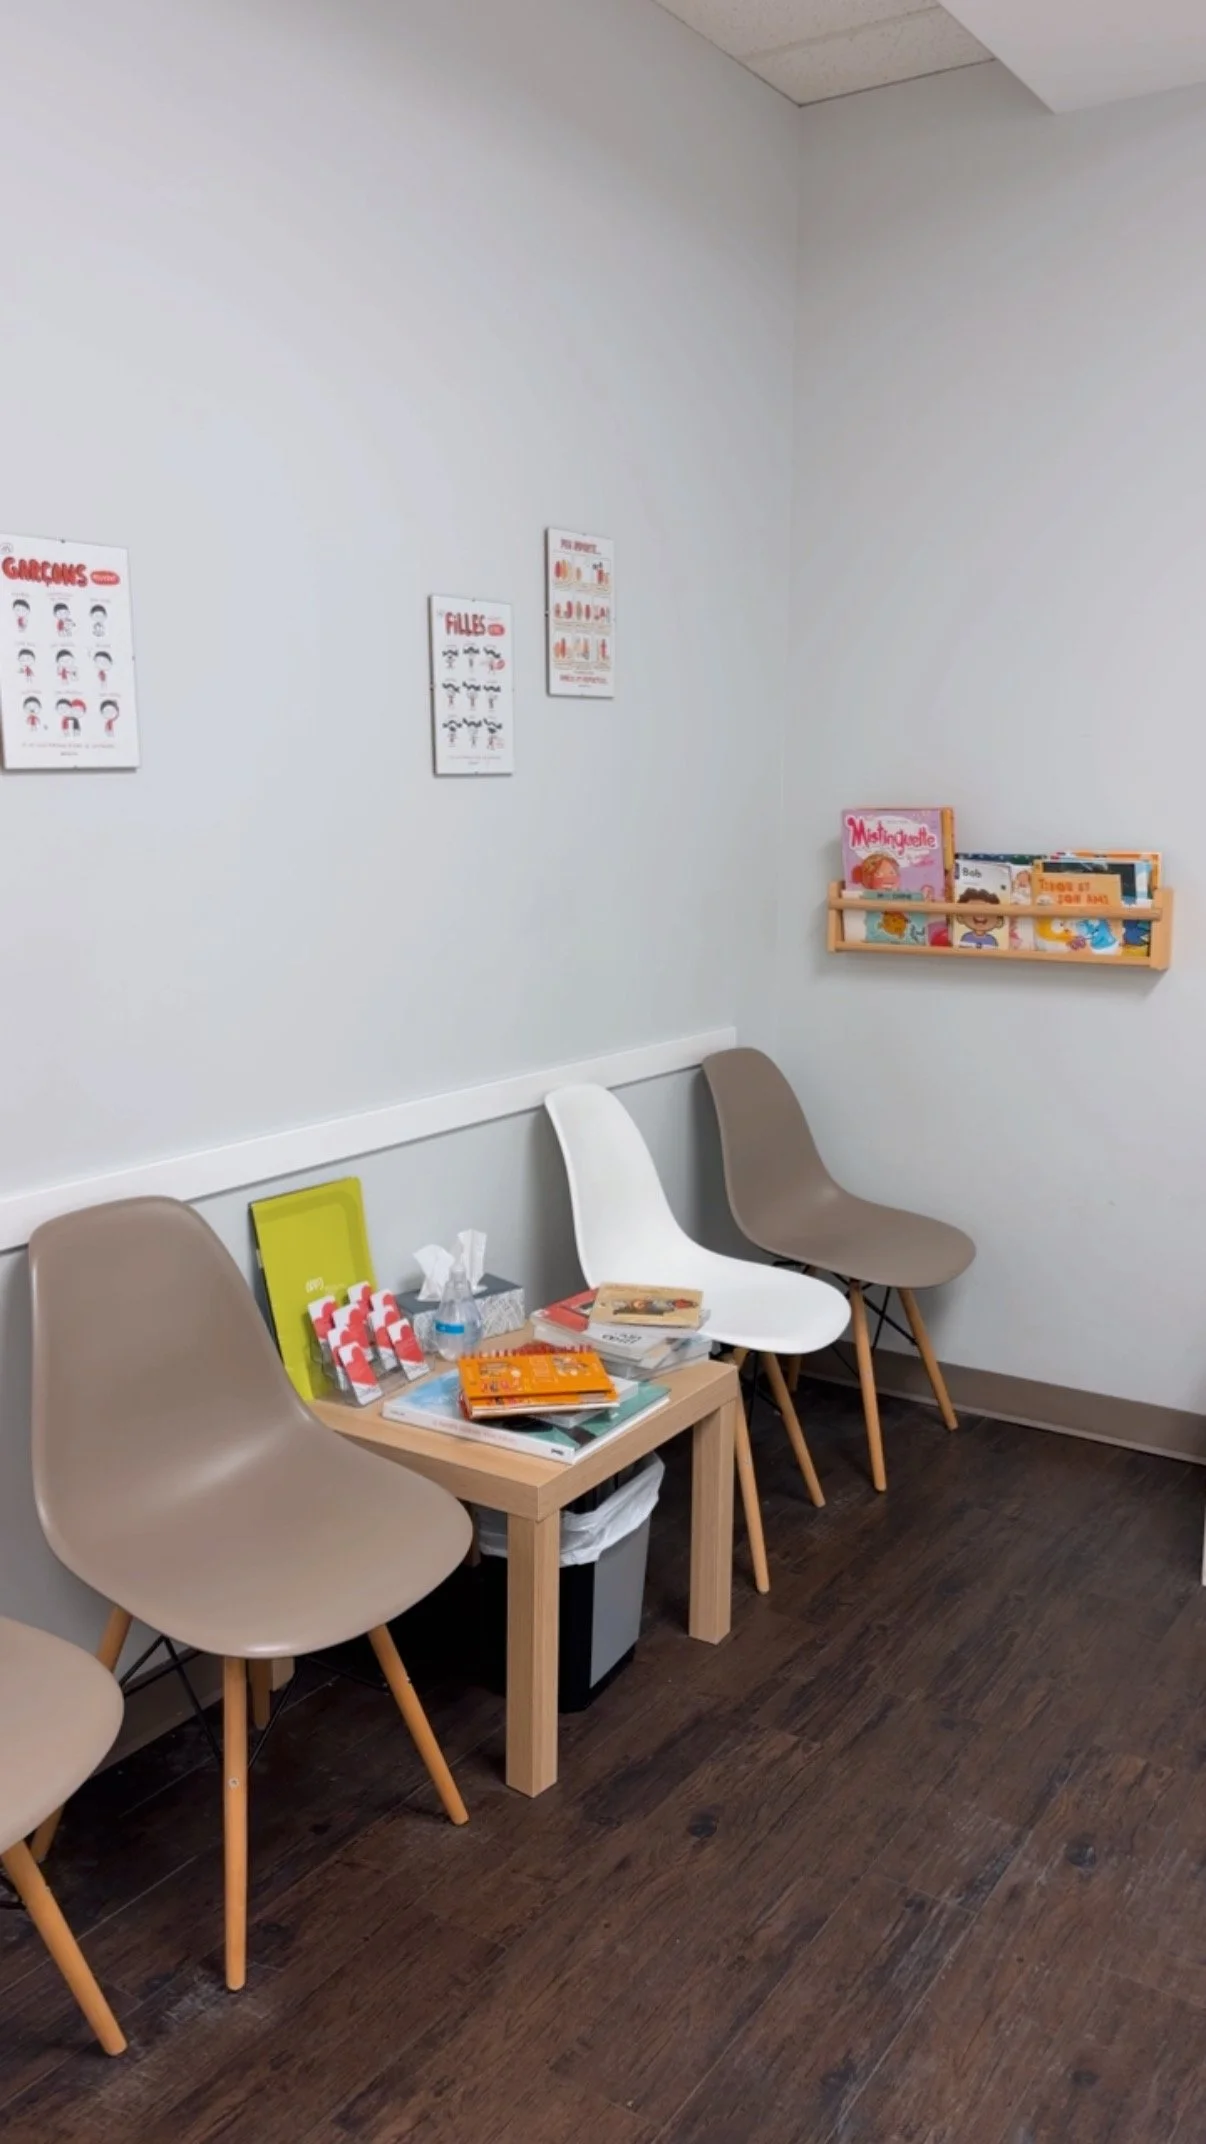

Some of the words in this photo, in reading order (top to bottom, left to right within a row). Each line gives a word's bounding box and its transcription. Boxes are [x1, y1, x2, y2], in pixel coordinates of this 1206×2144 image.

[2, 556, 88, 587] GARÇONS
[847, 817, 935, 856] Mistinguette
[962, 867, 982, 878] Bob
